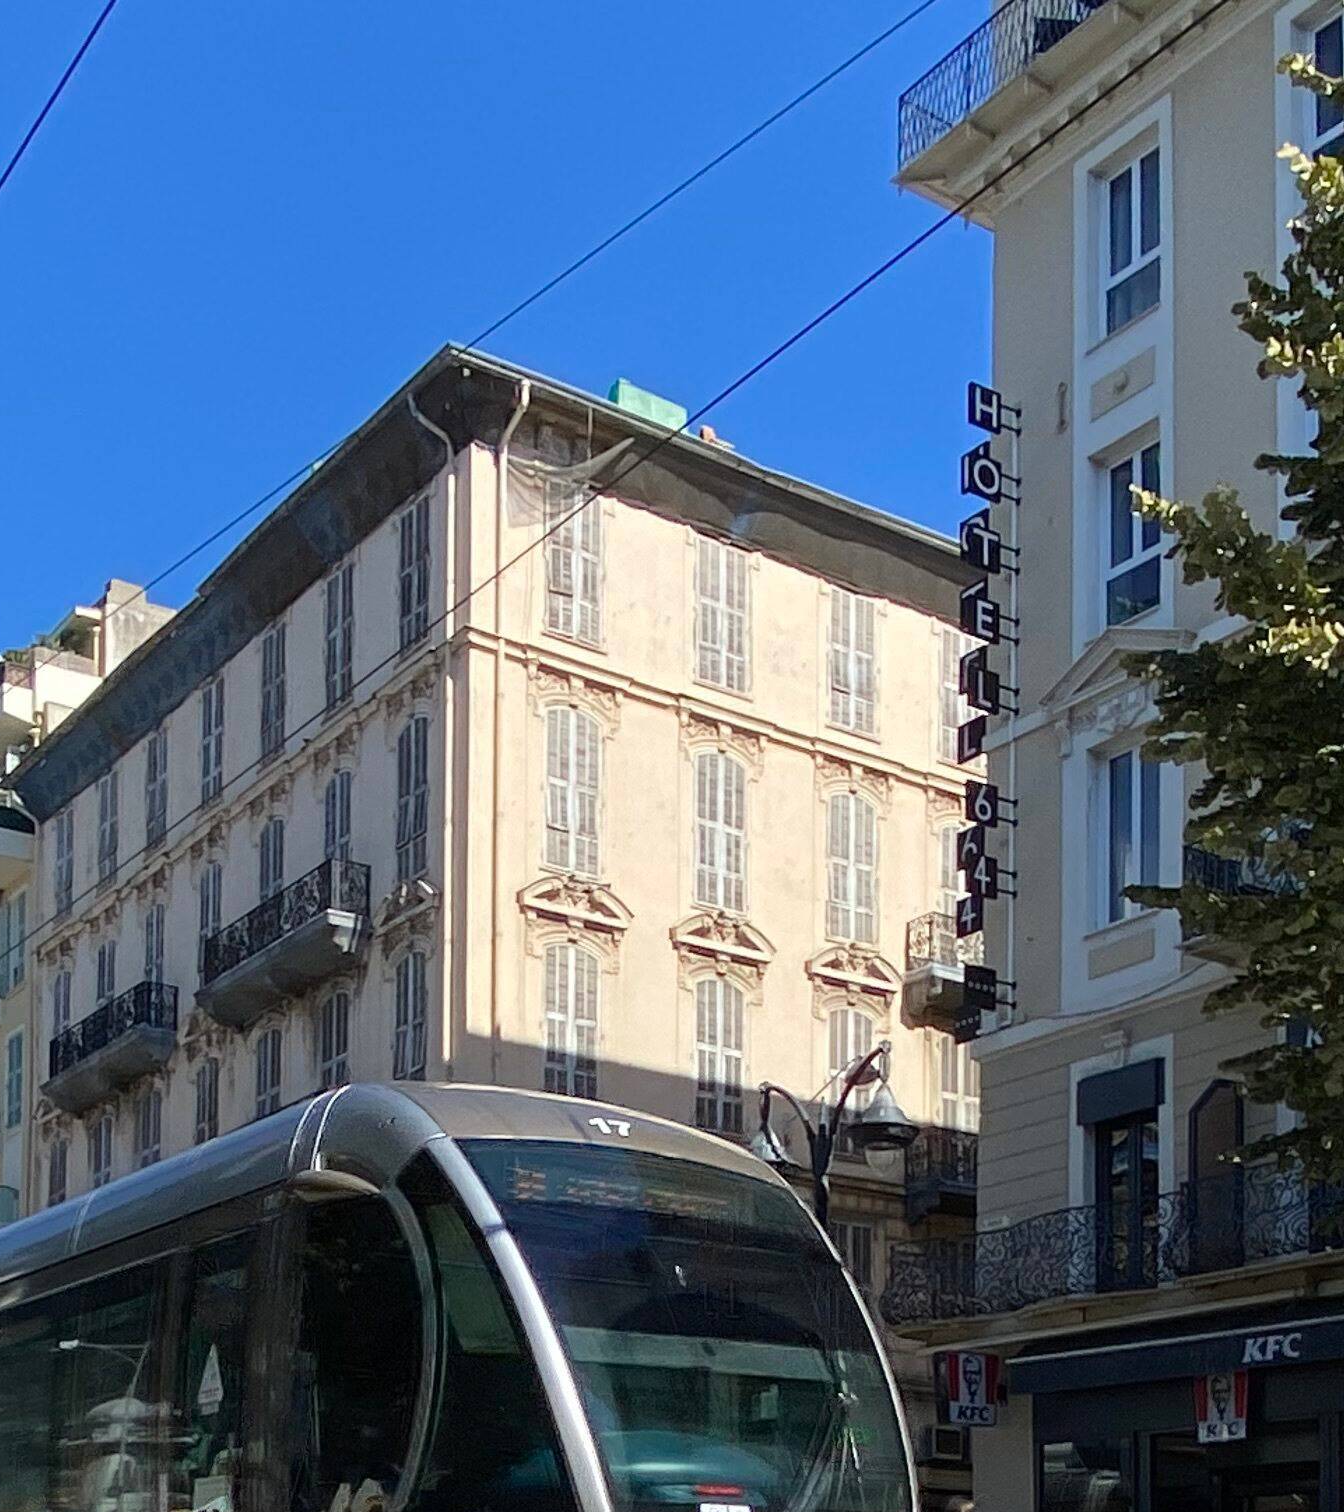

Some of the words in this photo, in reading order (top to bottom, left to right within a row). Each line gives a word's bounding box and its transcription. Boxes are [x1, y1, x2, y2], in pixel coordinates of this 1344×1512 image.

[974, 786, 993, 895] 64
[588, 1116, 632, 1138] 17
[1241, 1332, 1304, 1365] KFC
[956, 1404, 992, 1423] KFC
[1206, 1422, 1239, 1437] KC
